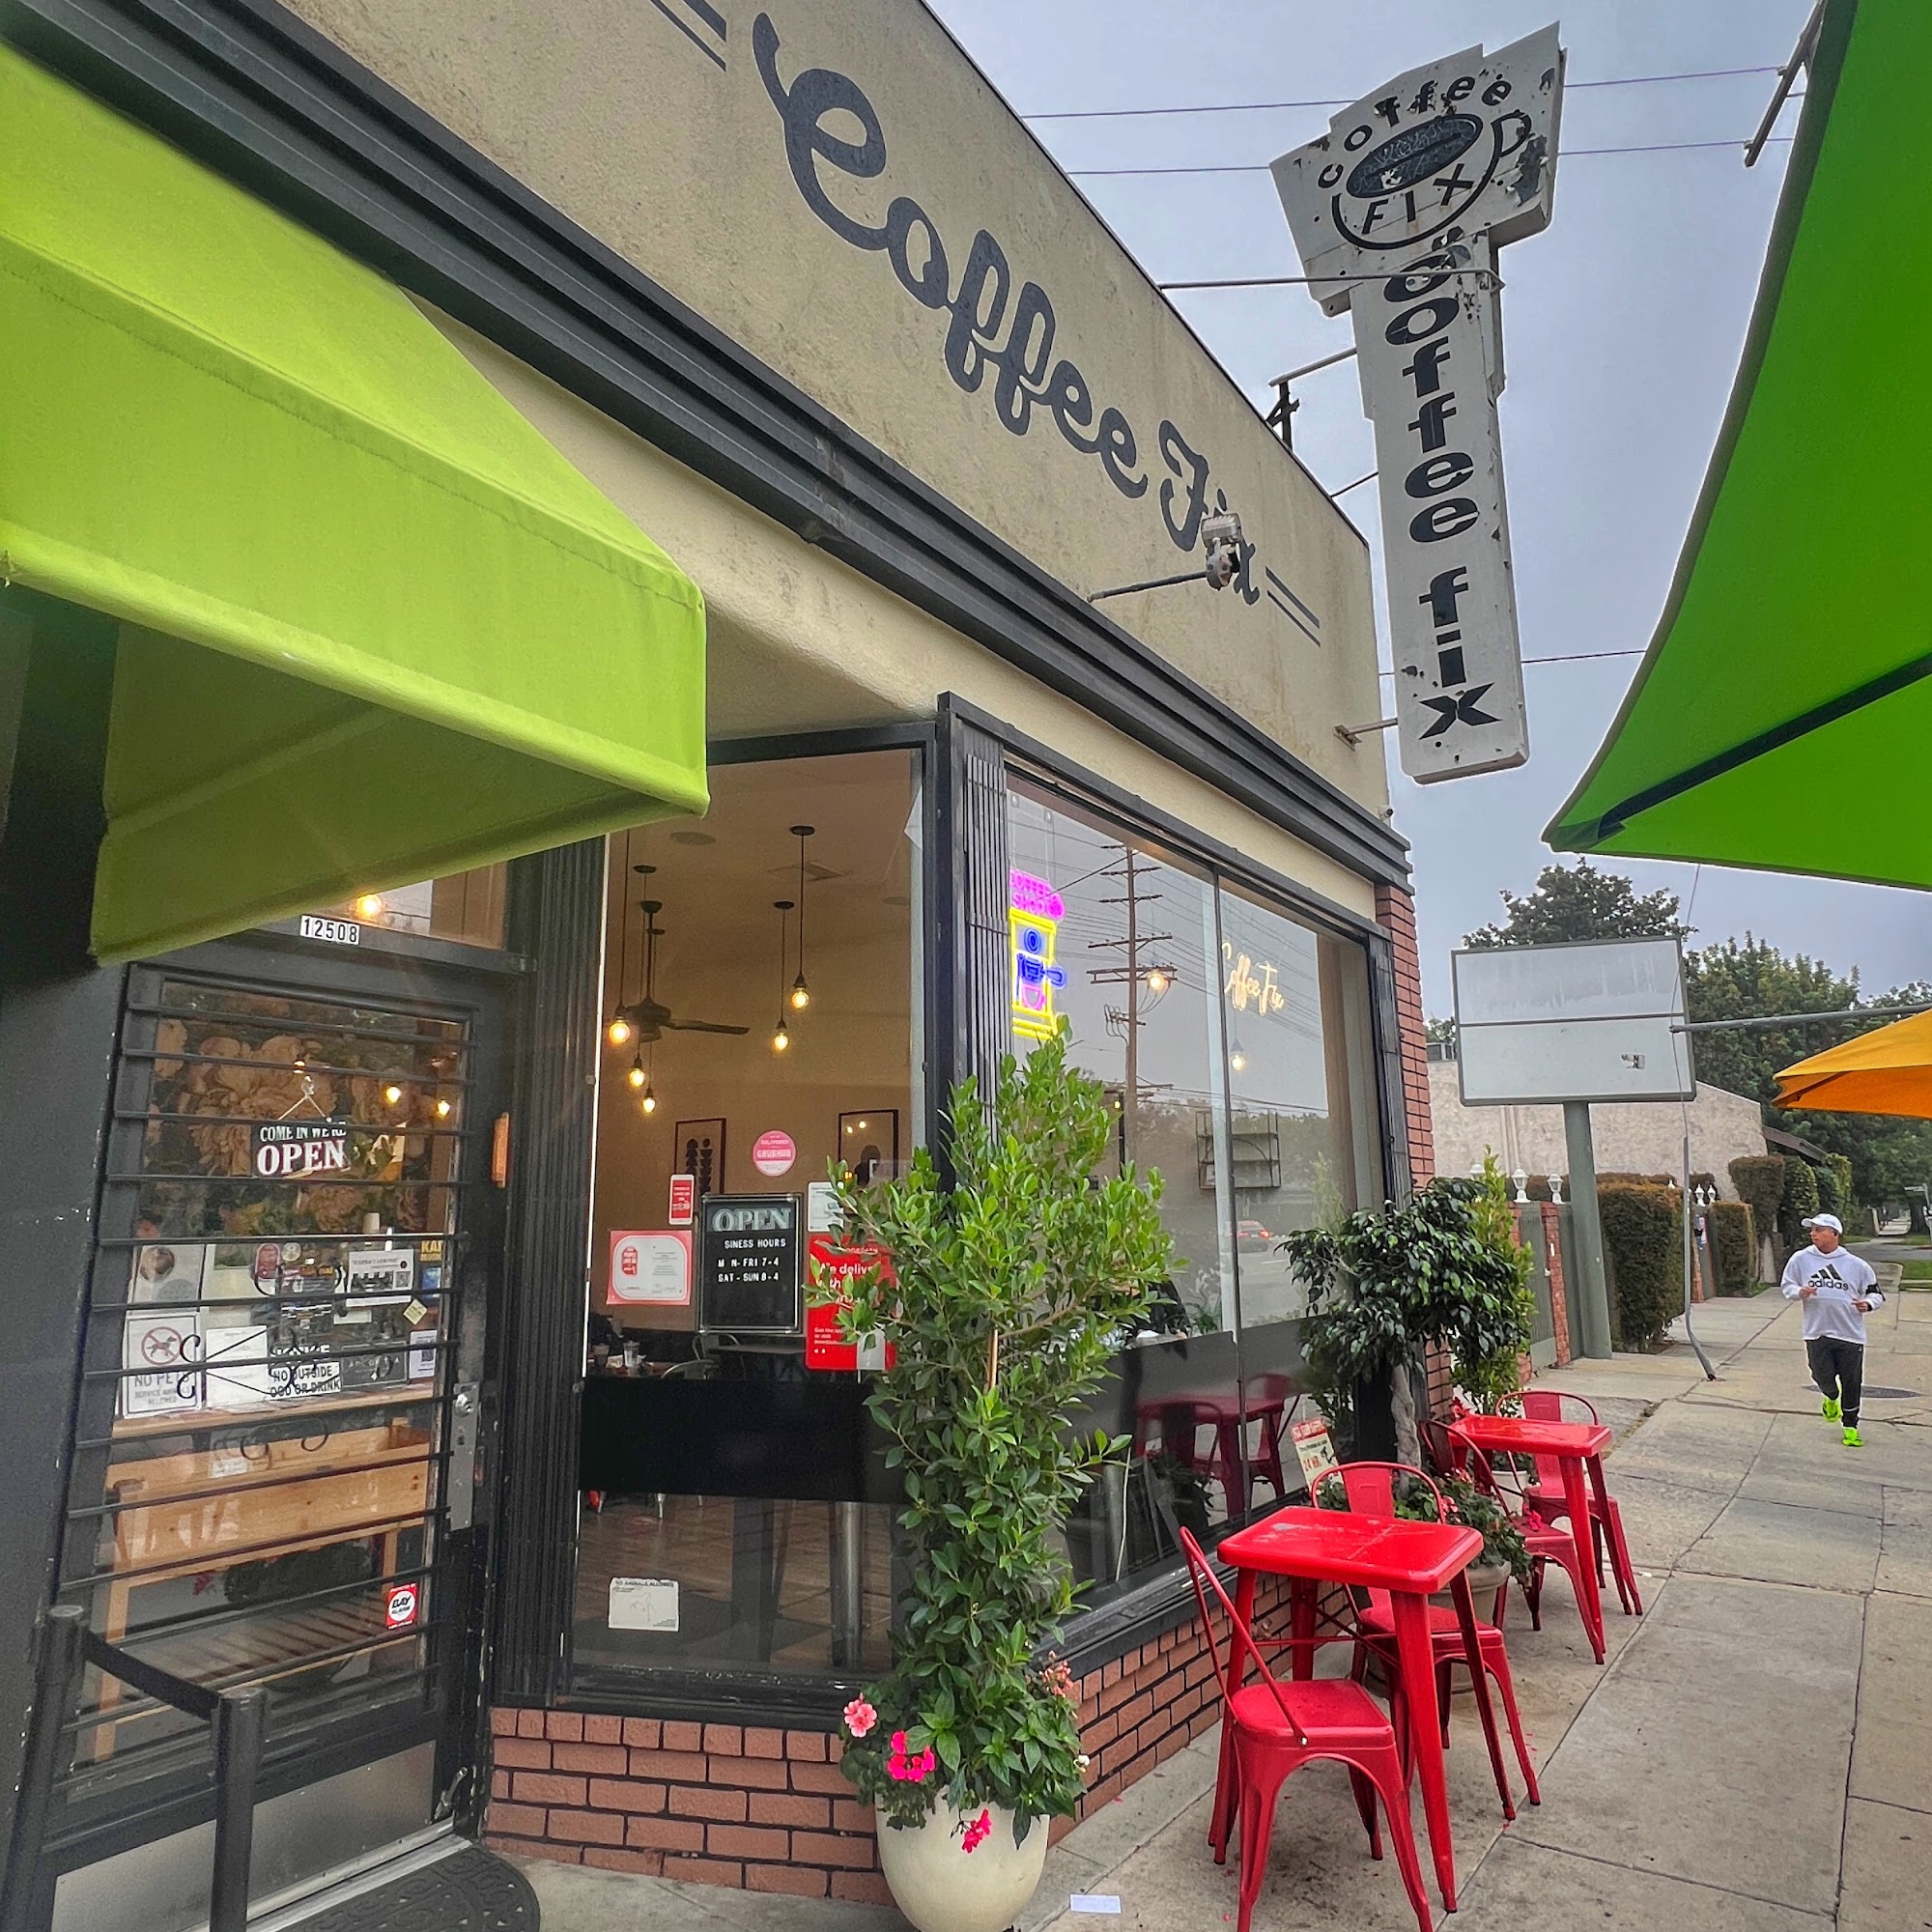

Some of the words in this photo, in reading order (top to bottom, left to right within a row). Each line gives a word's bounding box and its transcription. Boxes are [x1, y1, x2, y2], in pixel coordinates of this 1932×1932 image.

[1361, 162, 1475, 235] FIX
[1159, 419, 1260, 606] Fx
[1418, 566, 1503, 741] fix
[1012, 891, 1045, 915] SHOP
[303, 917, 358, 944] 12508
[260, 1124, 294, 1143] COME
[296, 1126, 308, 1140] IN
[257, 1140, 346, 1176] OPEN
[713, 1208, 791, 1232] OPEN
[757, 1237, 786, 1247] HOURS
[838, 1262, 874, 1275] deliv
[1807, 1279, 1849, 1292] adidas
[273, 1369, 288, 1382] NO
[270, 1385, 292, 1398] OOD
